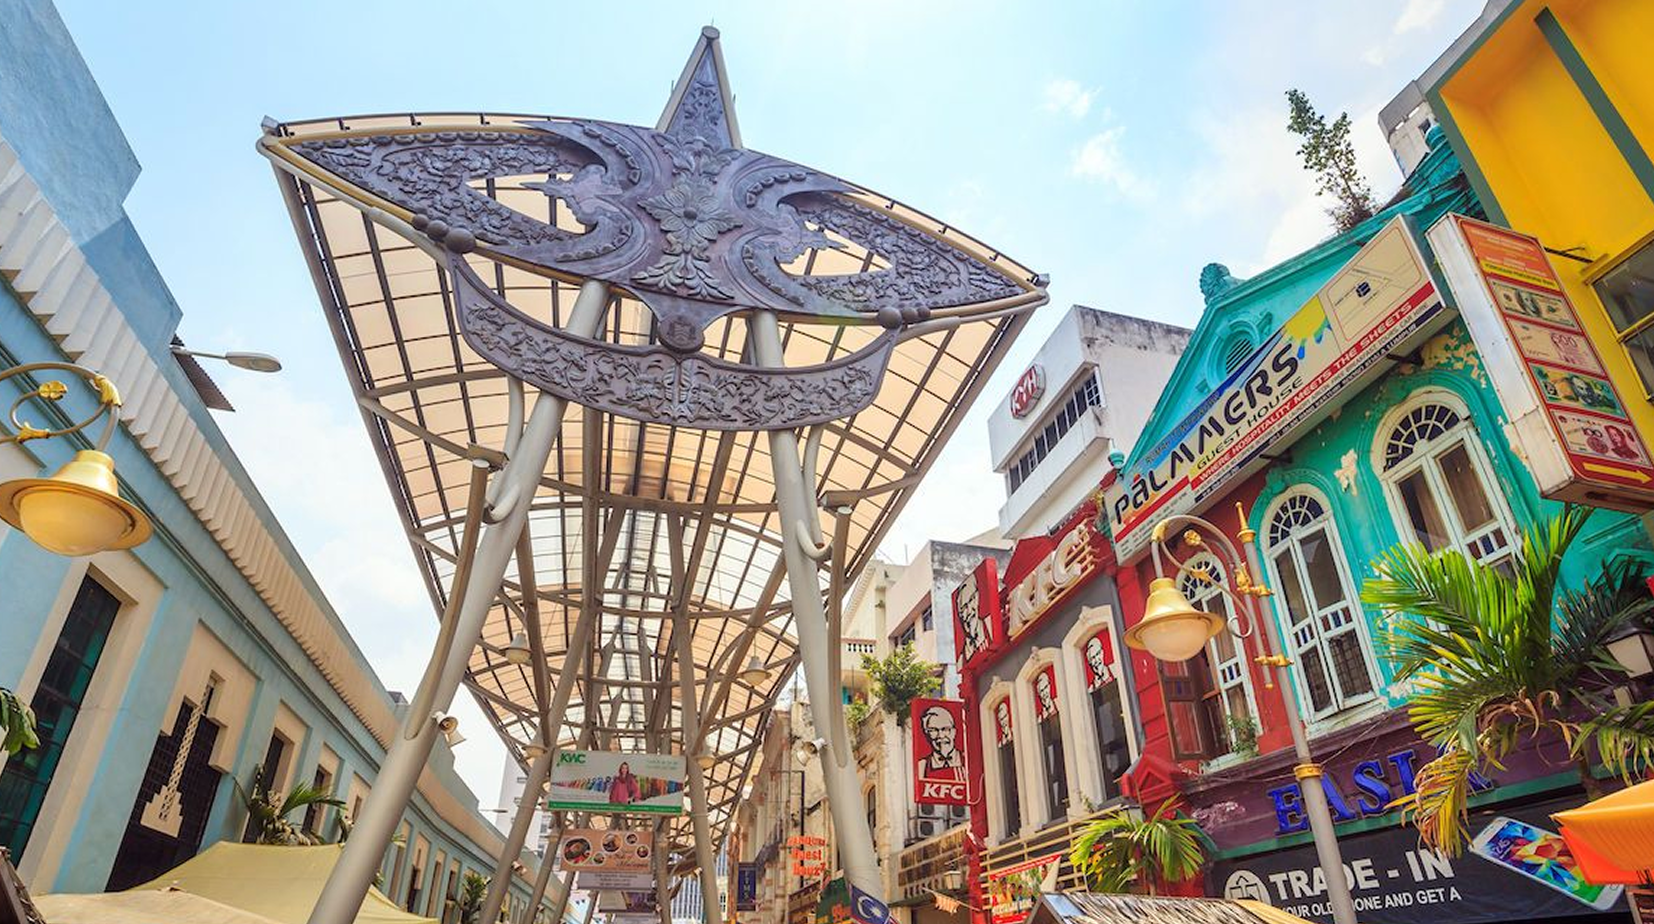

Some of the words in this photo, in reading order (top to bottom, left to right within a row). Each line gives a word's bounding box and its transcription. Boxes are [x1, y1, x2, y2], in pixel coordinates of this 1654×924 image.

[1196, 425, 1243, 471] GUEST
[1246, 374, 1304, 428] HOUSE
[1199, 451, 1231, 483] WHERE
[1231, 400, 1293, 456] HOSPITALITY
[1292, 367, 1333, 405] MEETS
[1333, 345, 1359, 372] THE
[1359, 300, 1413, 350] SHEETS
[1007, 525, 1087, 637] KFC
[922, 782, 965, 800] KFC
[1266, 744, 1494, 833] EASI
[1384, 892, 1413, 908] AND
[1415, 888, 1446, 905] GET
[1450, 886, 1462, 901] A
[1405, 847, 1455, 882] IN
